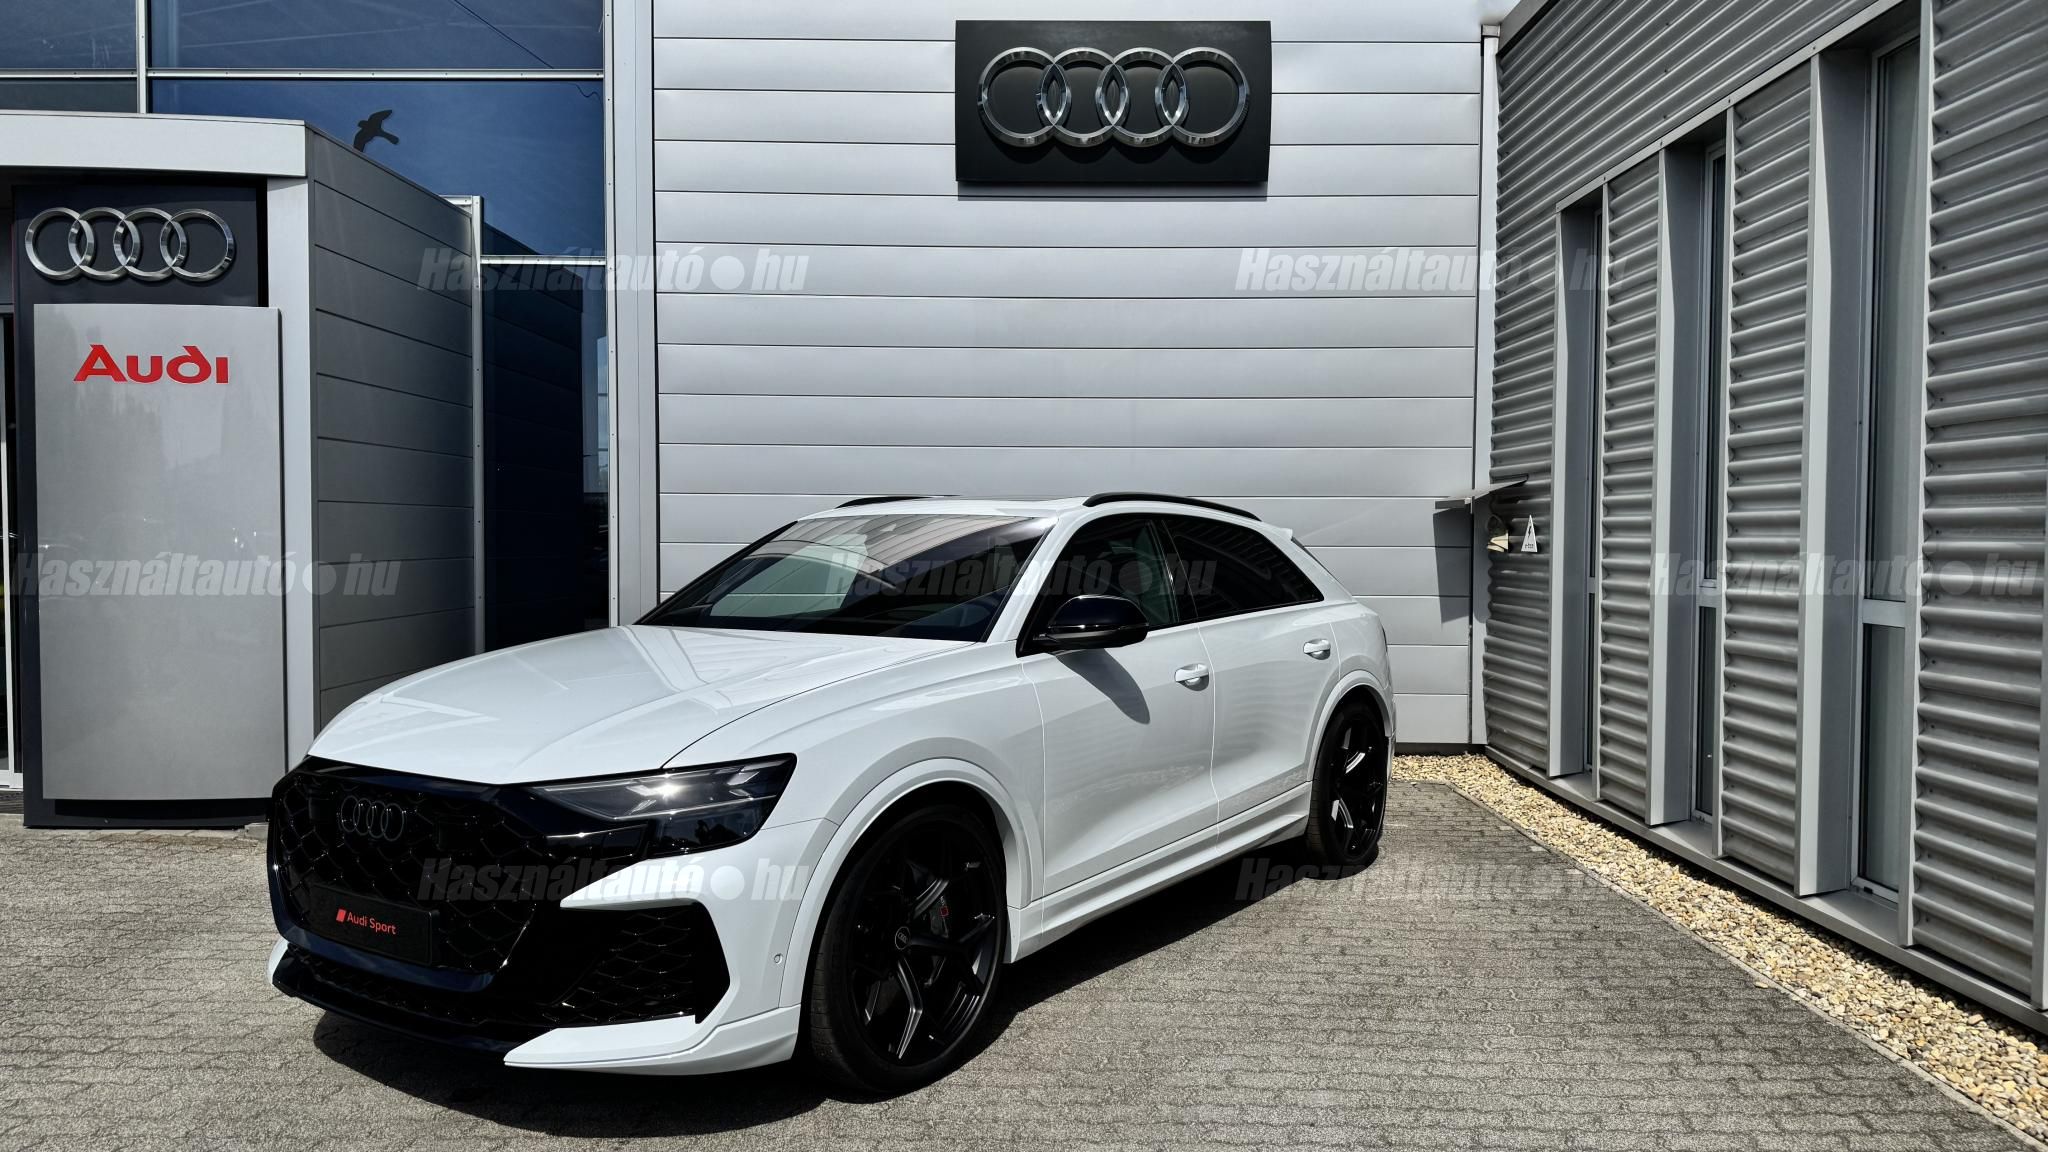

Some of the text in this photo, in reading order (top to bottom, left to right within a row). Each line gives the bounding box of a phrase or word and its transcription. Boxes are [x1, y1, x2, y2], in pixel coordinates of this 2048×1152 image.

[73, 344, 230, 384] Audi
[347, 912, 397, 935] Audi Sport
